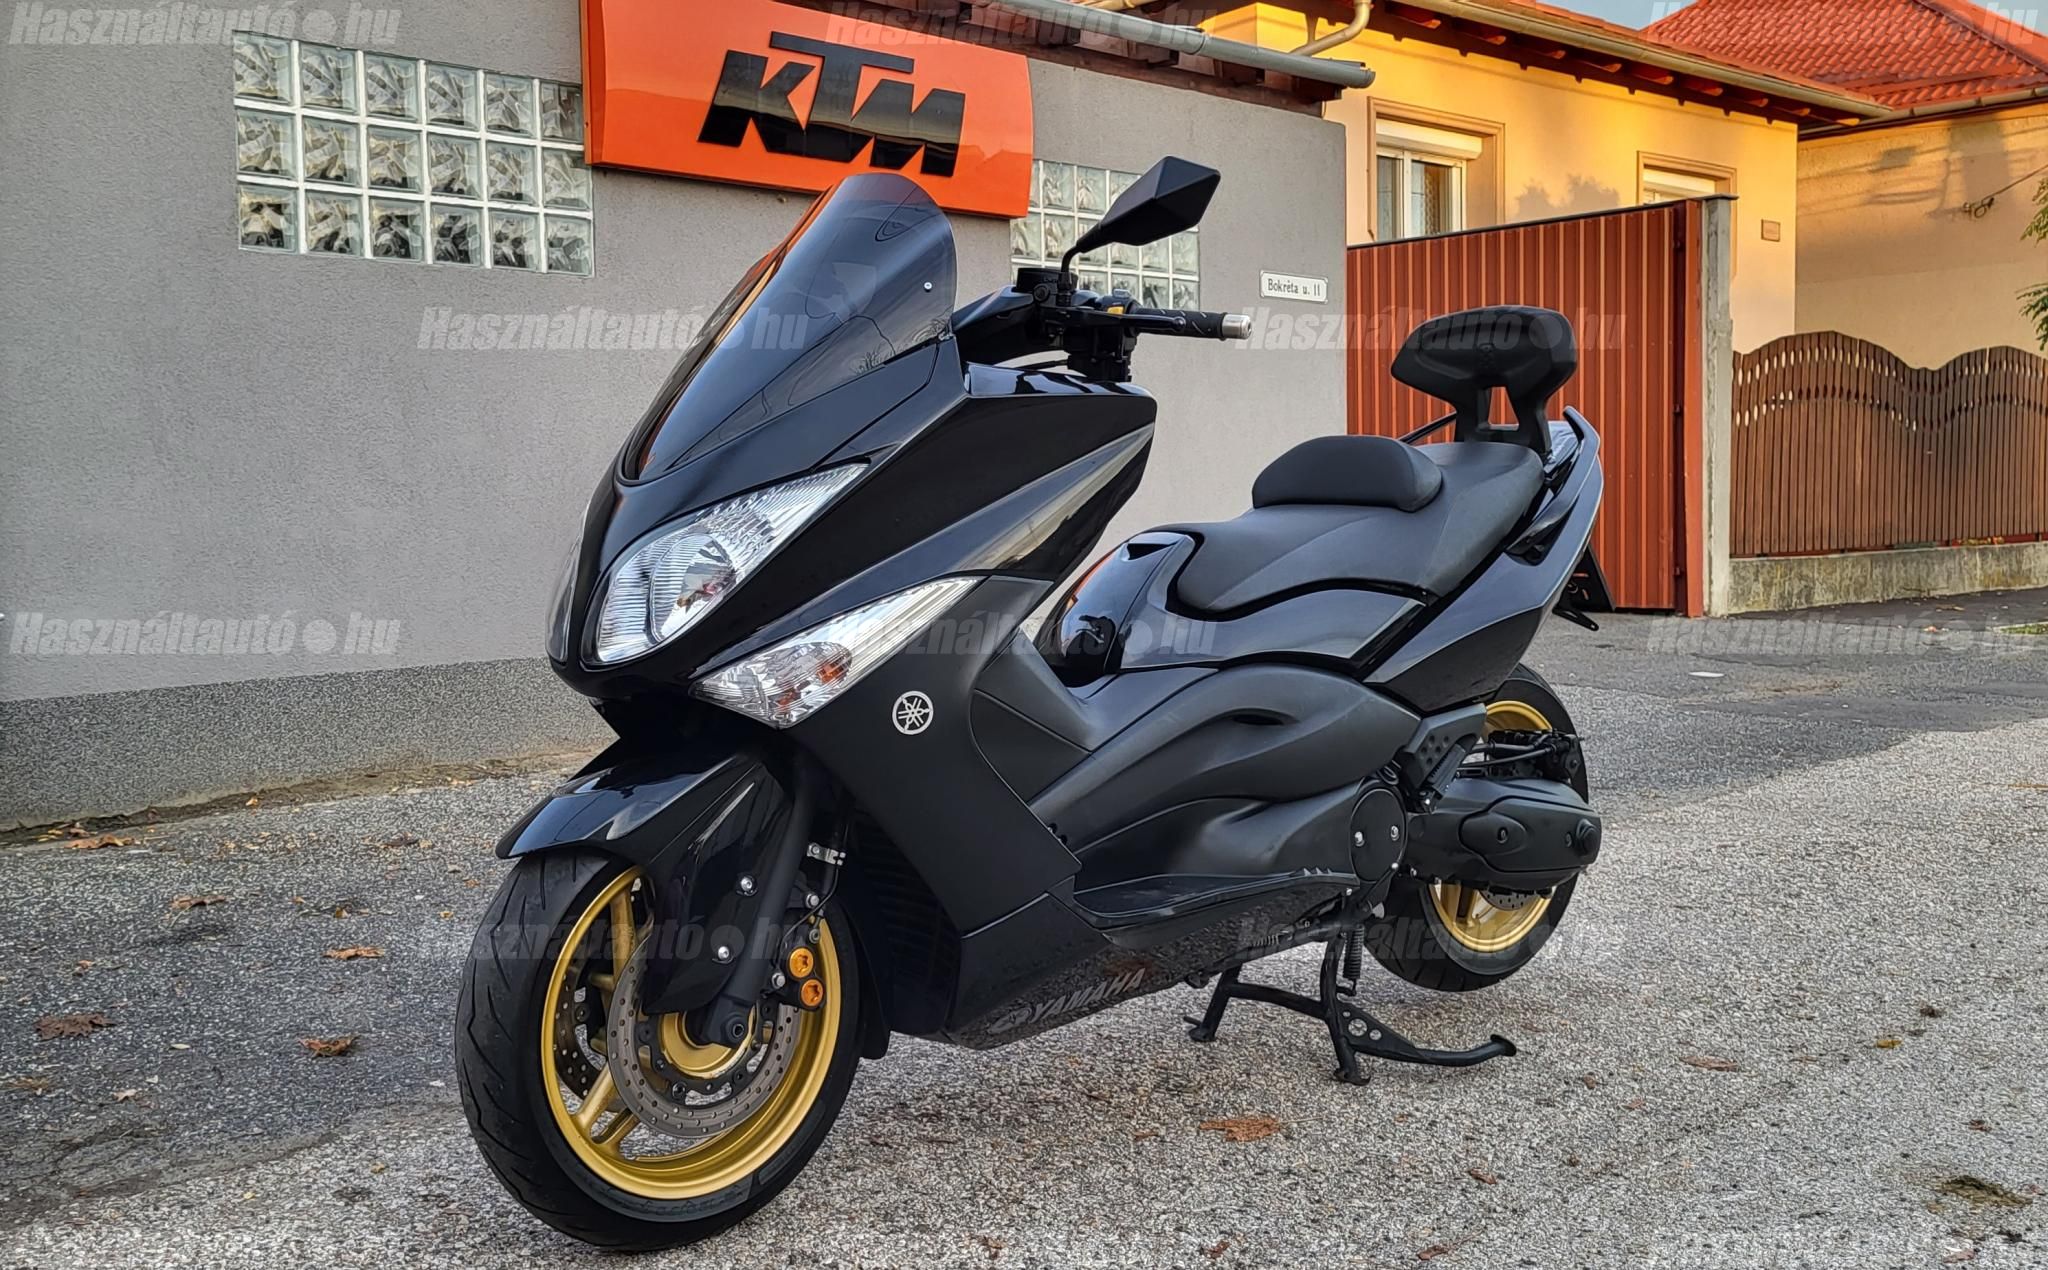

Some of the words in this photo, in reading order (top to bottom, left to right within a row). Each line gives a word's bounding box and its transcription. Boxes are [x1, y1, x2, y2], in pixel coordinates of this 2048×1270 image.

[698, 31, 966, 177] KTM
[1302, 285, 1310, 295] u.
[1029, 968, 1145, 1024] YAMAHA
